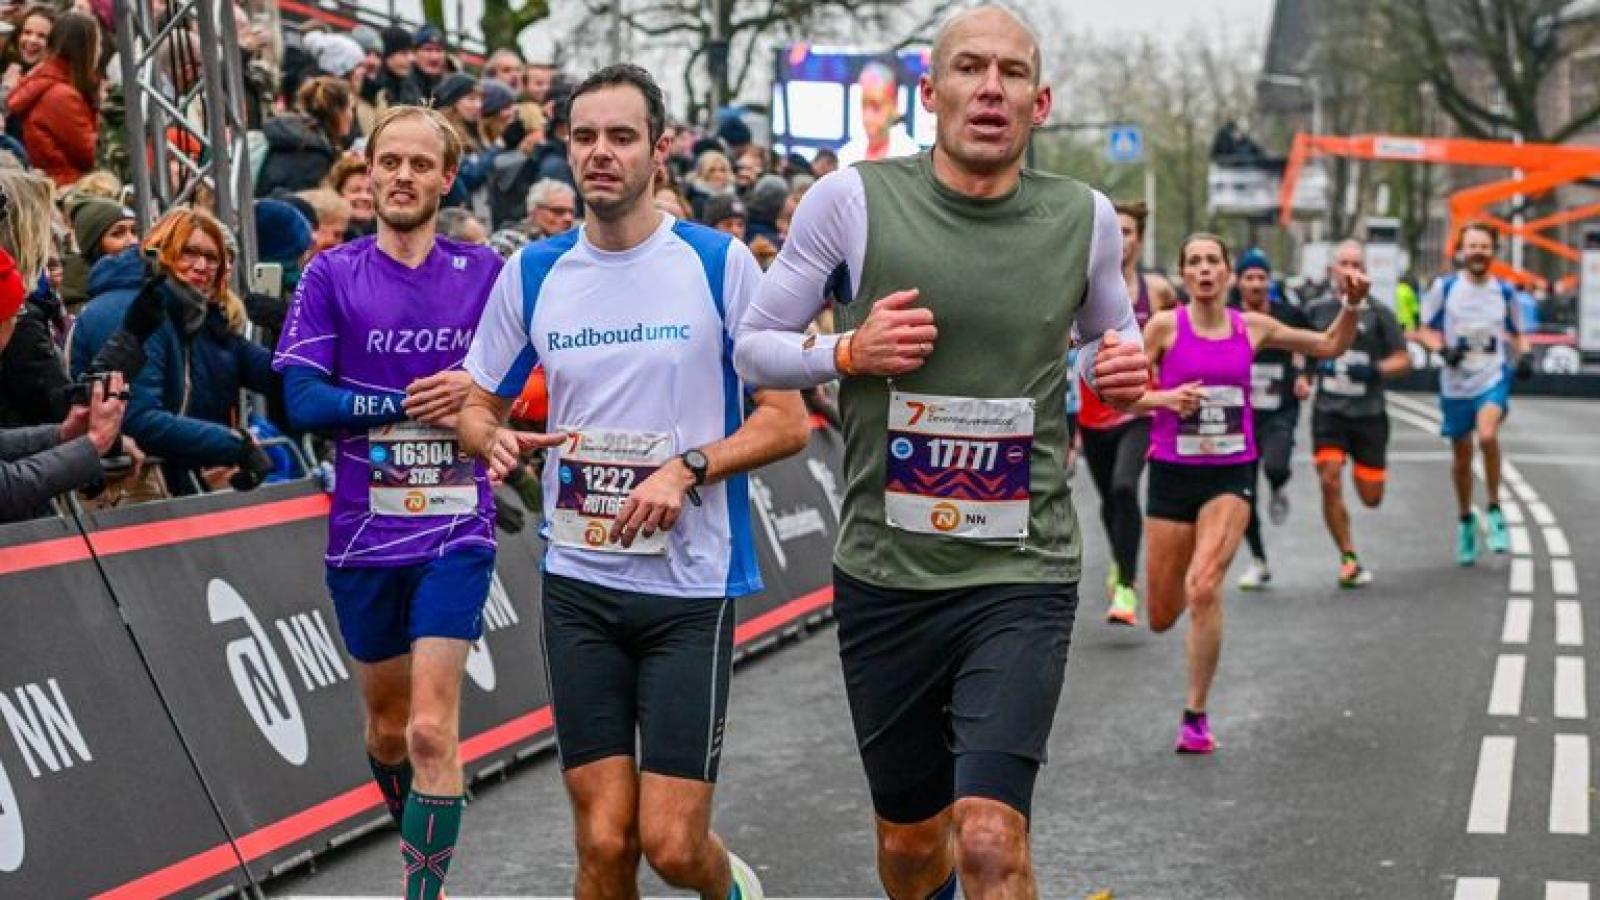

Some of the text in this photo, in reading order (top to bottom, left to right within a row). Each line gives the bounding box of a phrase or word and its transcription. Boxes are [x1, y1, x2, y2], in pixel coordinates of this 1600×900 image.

[366, 327, 472, 353] RIZOEM
[547, 322, 691, 352] Radboudumc
[353, 395, 397, 416] BEA
[391, 442, 453, 466] 16304
[926, 438, 999, 472] 17777
[581, 465, 635, 494] 1222
[965, 513, 987, 526] NN
[275, 609, 349, 691] NN
